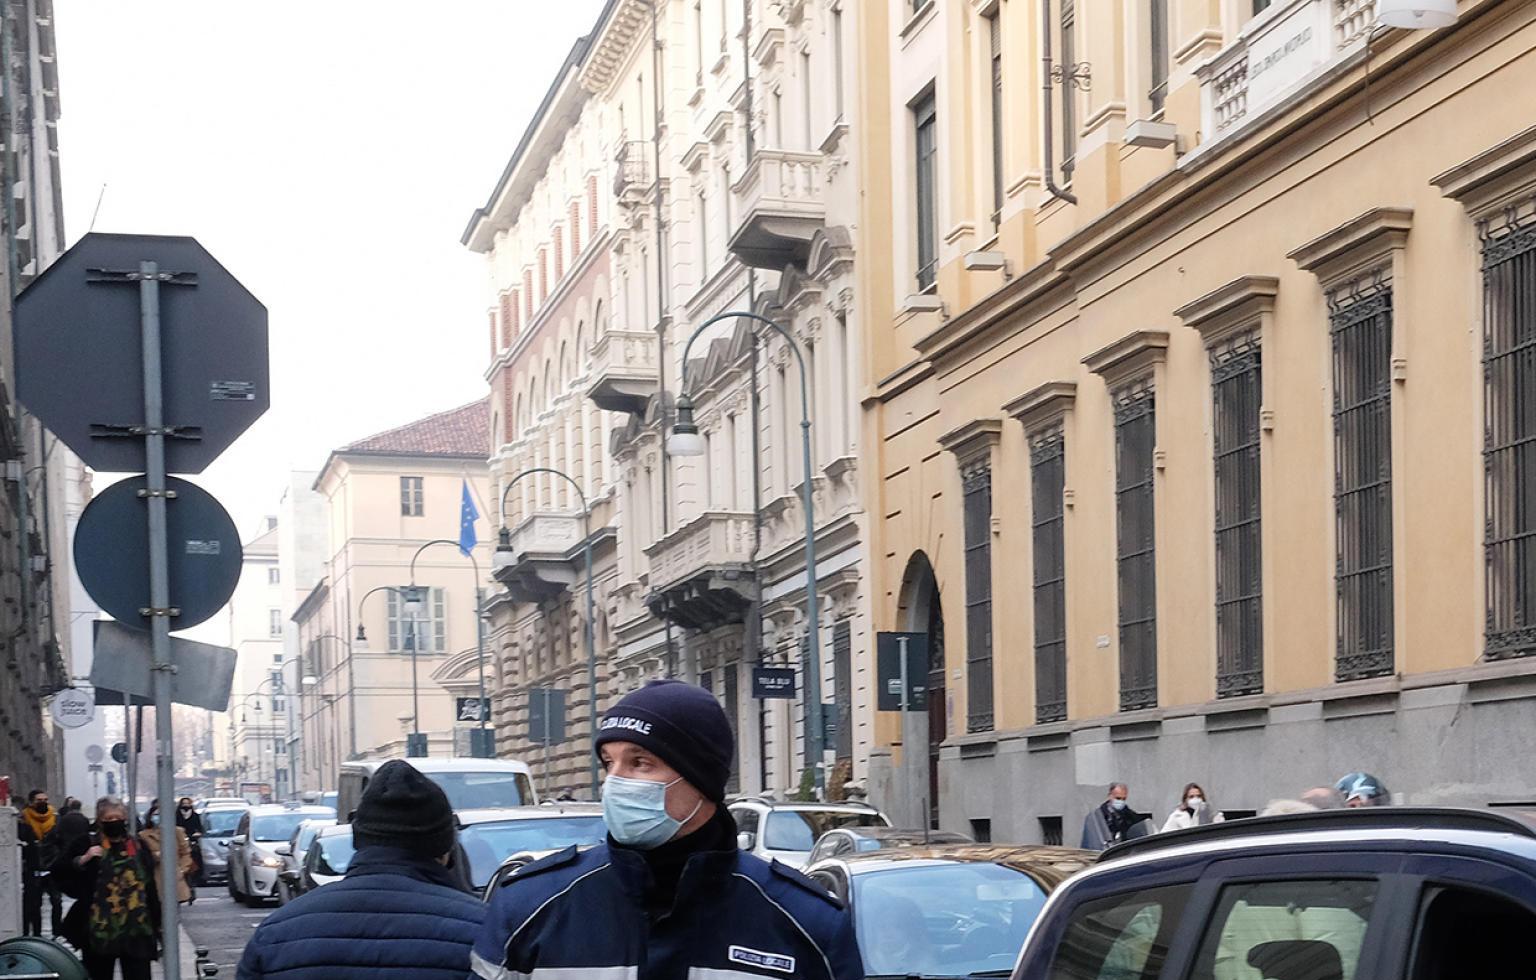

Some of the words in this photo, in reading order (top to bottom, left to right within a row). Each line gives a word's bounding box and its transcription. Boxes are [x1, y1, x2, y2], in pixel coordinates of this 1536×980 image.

[617, 716, 653, 735] LOCALE
[734, 950, 762, 963] POLIZIA
[762, 955, 791, 969] LOCALE
